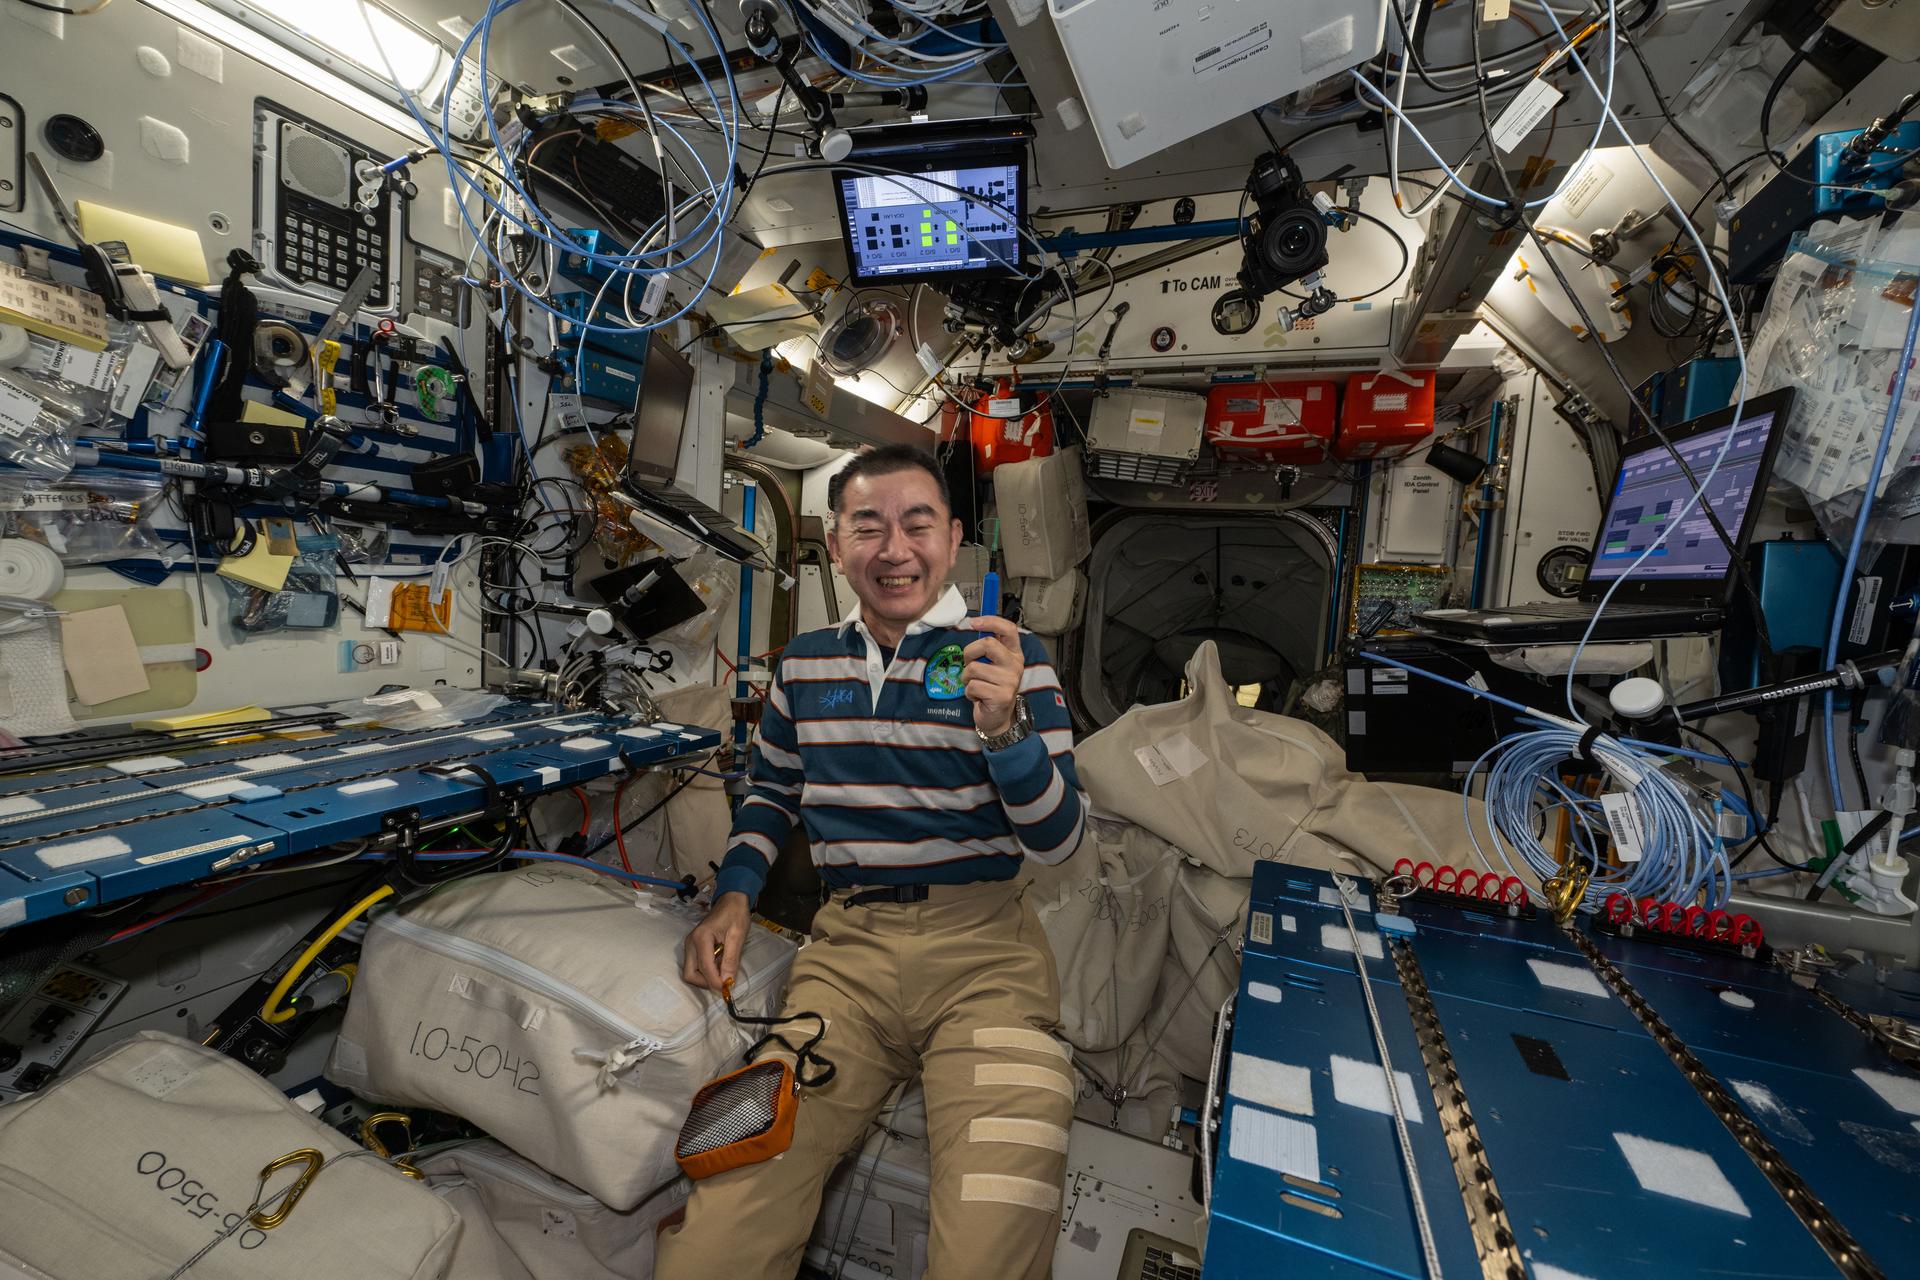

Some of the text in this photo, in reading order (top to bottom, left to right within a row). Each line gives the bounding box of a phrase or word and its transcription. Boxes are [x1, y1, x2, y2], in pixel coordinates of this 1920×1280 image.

[1172, 275, 1221, 292] To CAM
[1412, 474, 1432, 482] Zenith
[1193, 485, 1214, 498] EXIT
[1412, 487, 1430, 495] Panel
[1762, 677, 1839, 701] Manfrotto
[408, 1020, 541, 1097] 1.0-5042
